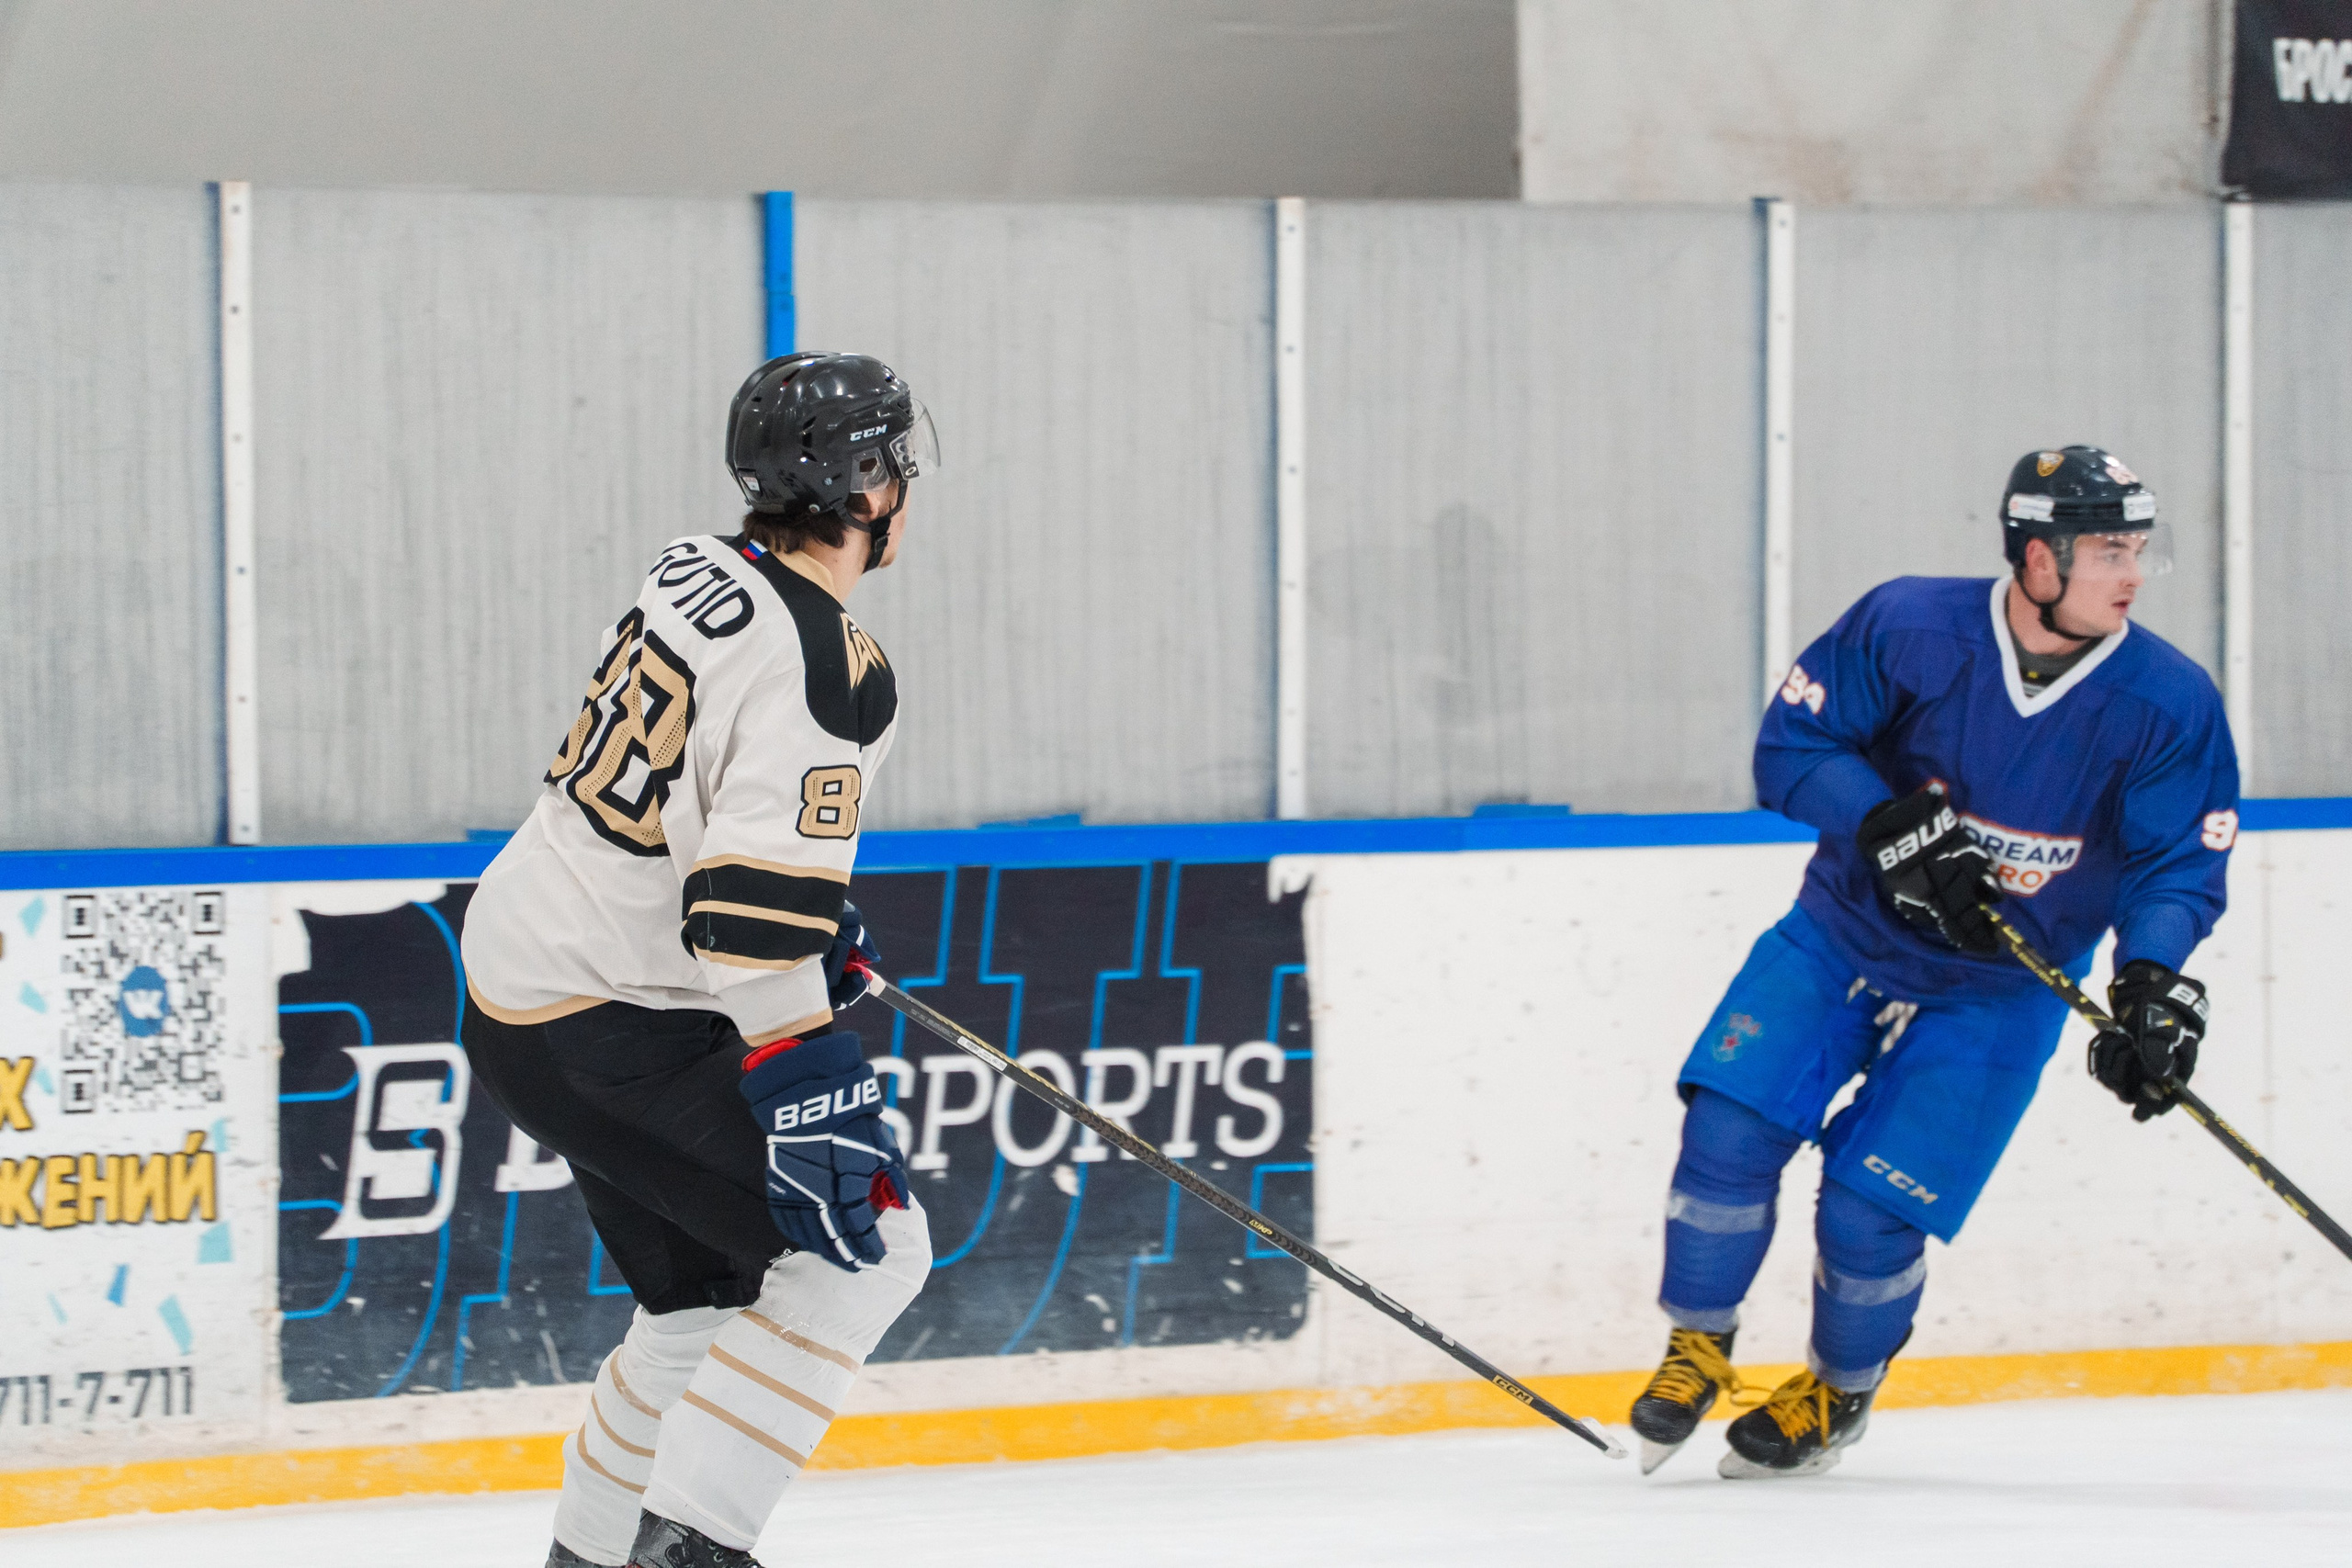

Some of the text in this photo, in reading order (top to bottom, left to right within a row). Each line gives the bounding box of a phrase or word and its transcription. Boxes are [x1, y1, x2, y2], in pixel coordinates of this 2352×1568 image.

[849, 423, 888, 442] CCM
[1862, 1154, 1939, 1204] CCM
[1495, 1377, 1532, 1403] CCM
